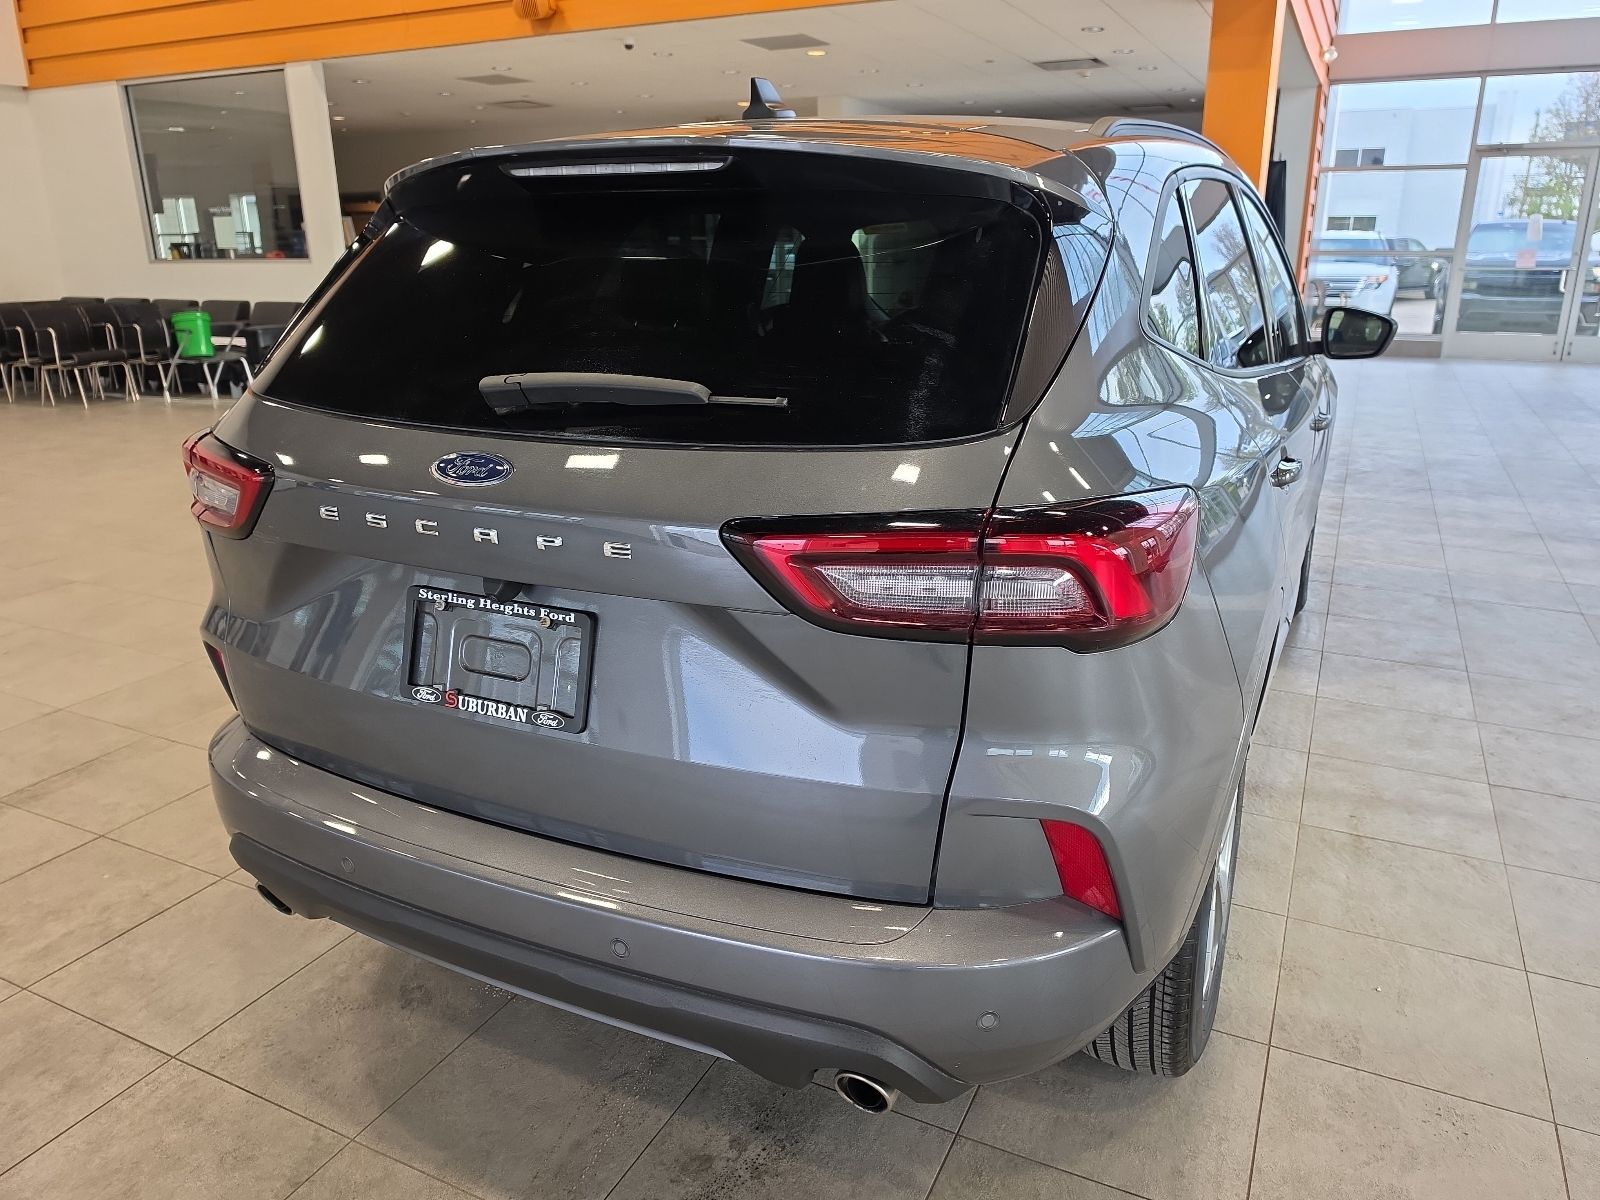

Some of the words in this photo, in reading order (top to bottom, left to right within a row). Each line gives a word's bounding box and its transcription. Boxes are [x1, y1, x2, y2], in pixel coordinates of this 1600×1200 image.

[446, 457, 492, 478] Ford
[319, 505, 632, 560] ESCAPE
[418, 588, 475, 609] Sterling
[480, 598, 536, 617] Heights
[540, 607, 575, 623] Ford
[417, 688, 436, 702] Ford
[445, 690, 528, 723] SUBURBAN
[537, 712, 560, 727] Ford
